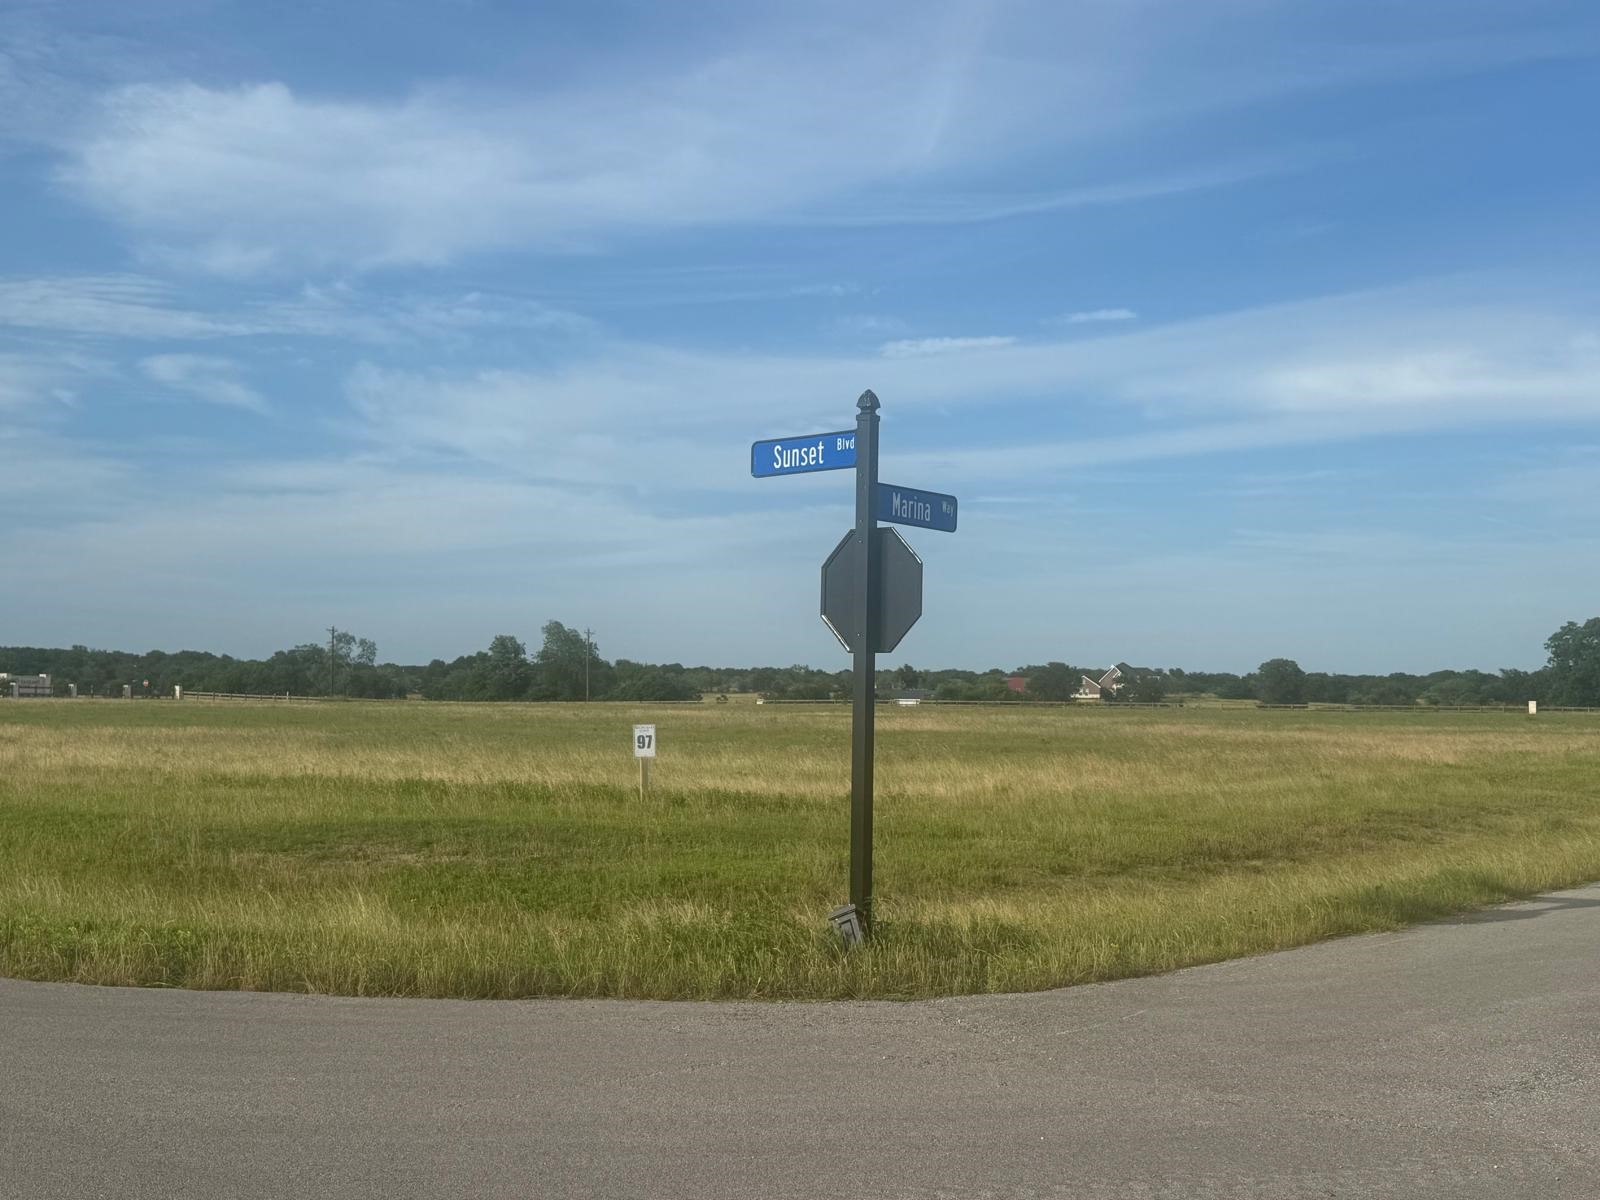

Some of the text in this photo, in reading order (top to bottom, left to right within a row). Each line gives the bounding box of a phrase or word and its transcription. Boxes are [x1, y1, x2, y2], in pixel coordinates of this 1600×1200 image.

[773, 437, 855, 469] Sunset Blvd
[892, 492, 954, 521] Marina Way
[637, 734, 653, 749] 97
